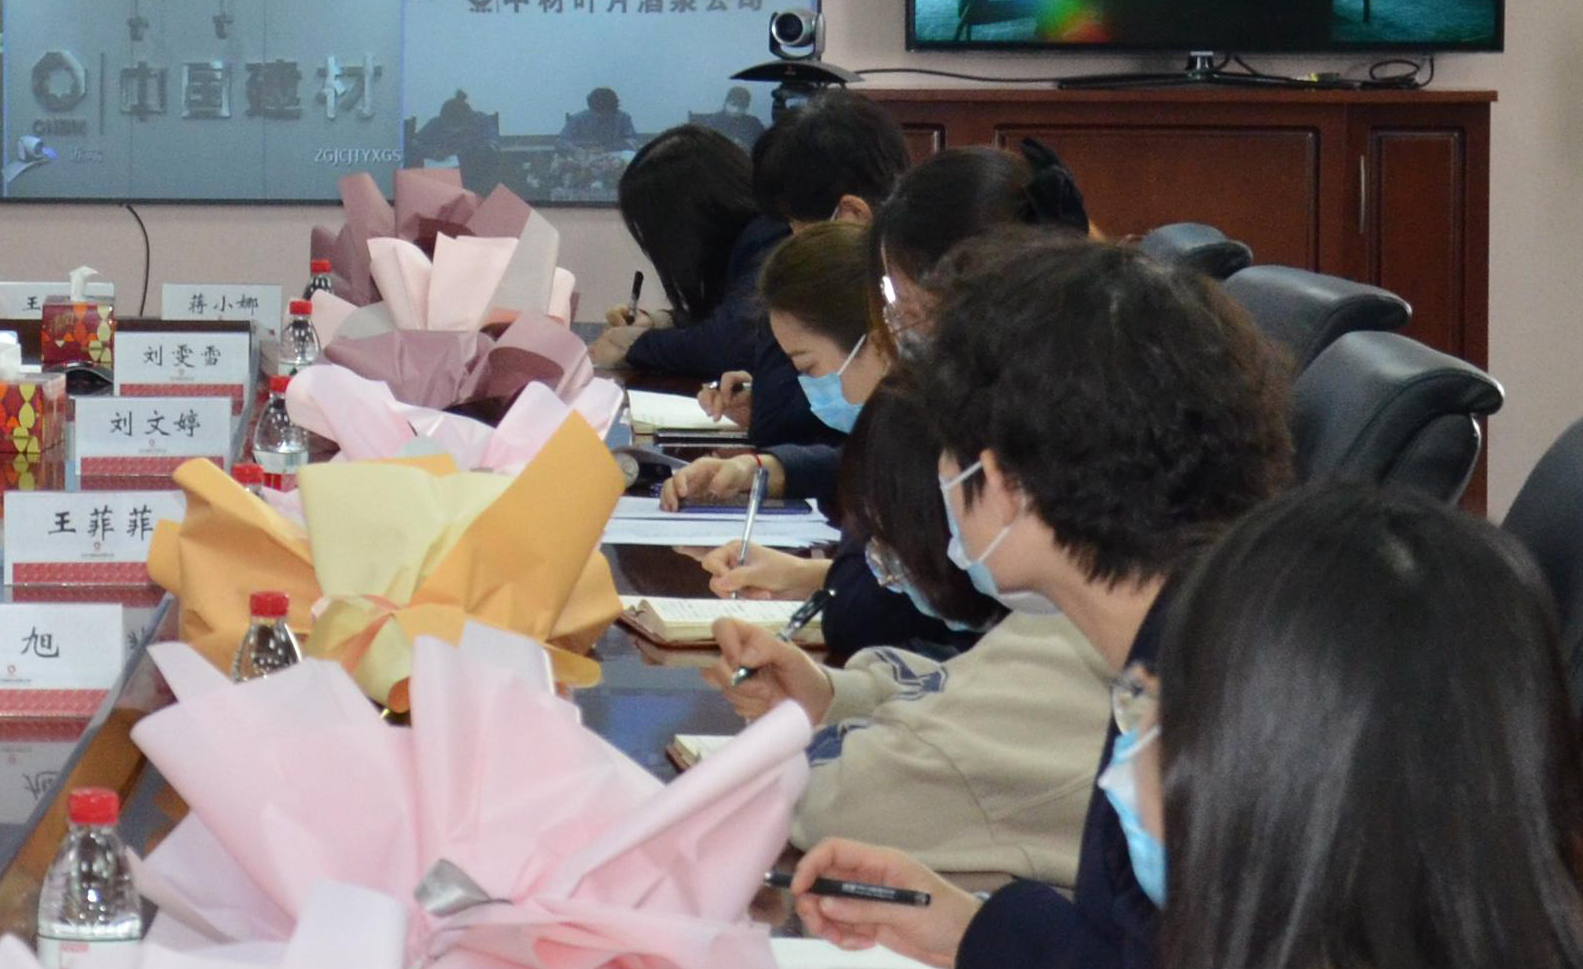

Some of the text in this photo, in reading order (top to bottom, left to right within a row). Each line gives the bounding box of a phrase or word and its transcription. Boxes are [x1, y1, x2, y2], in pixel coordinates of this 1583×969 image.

[120, 53, 383, 122] 中国建材
[188, 293, 259, 315] 蒋小娜
[110, 408, 201, 438] 刘文婷
[48, 505, 153, 541] 王菲菲
